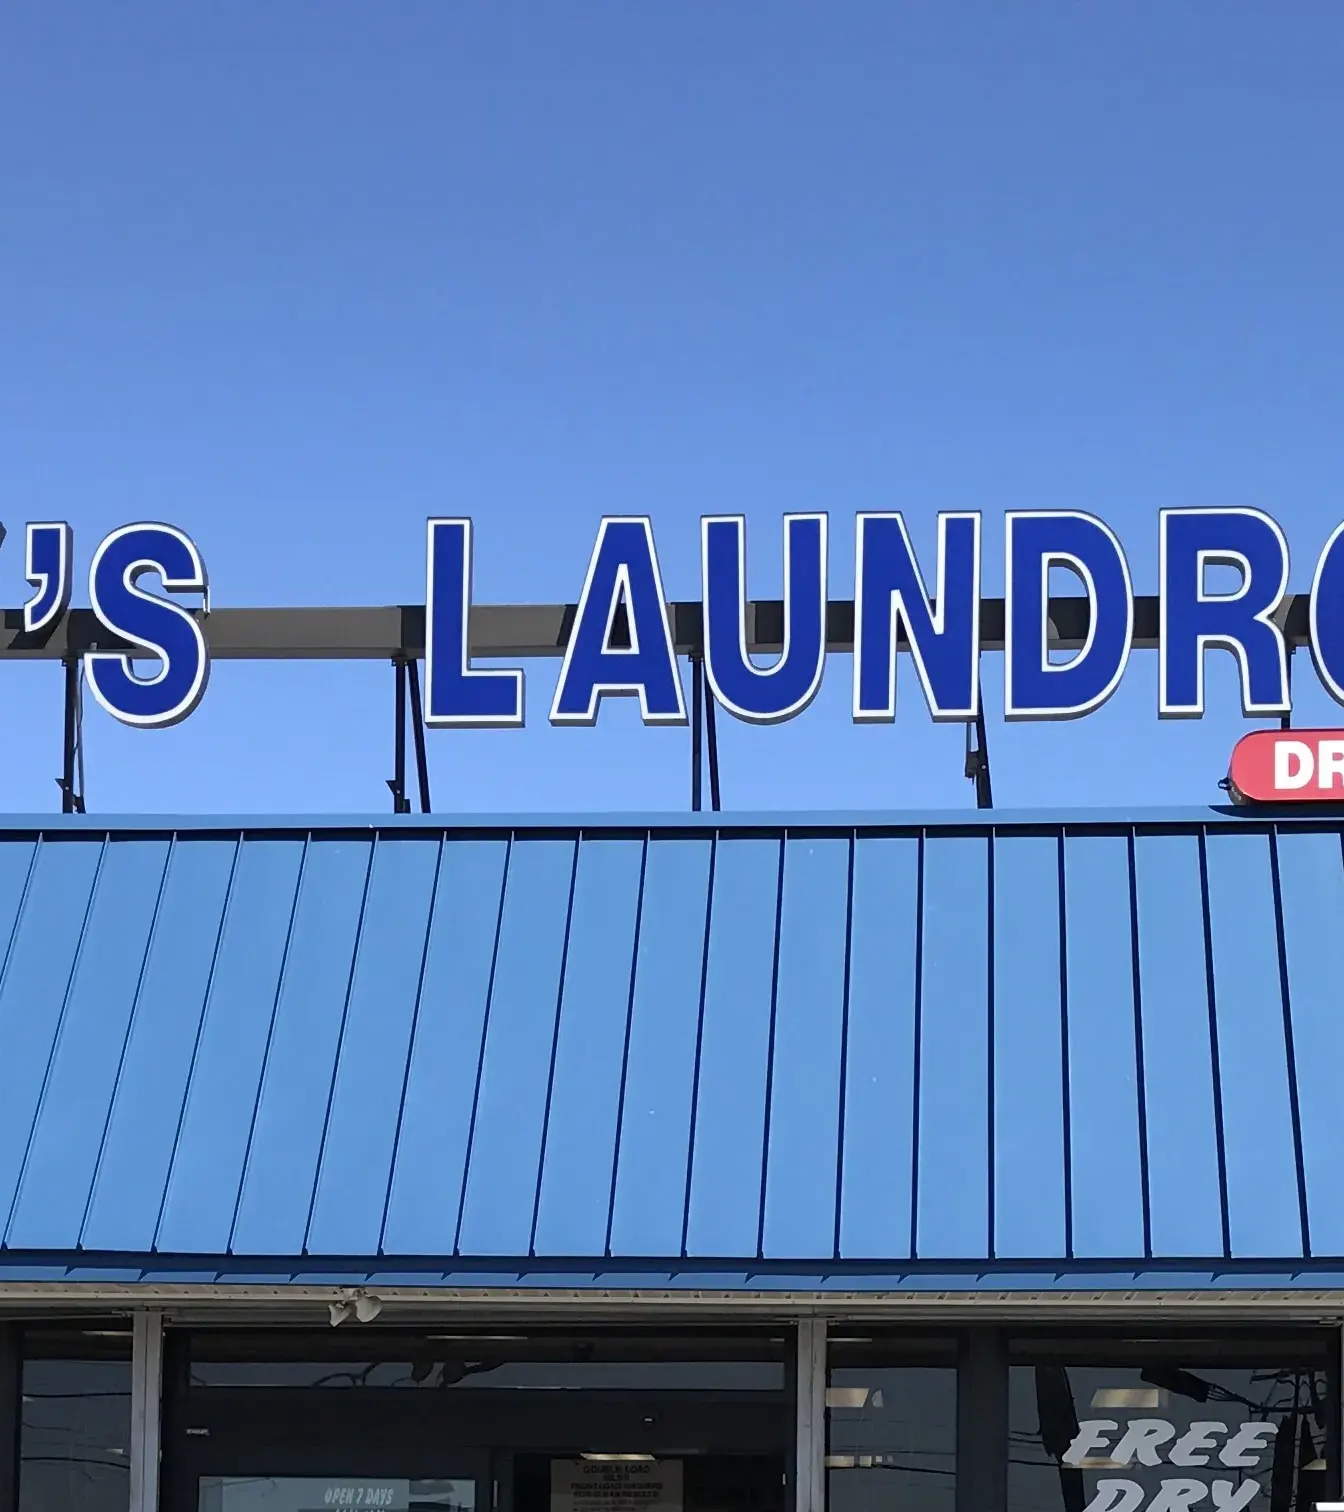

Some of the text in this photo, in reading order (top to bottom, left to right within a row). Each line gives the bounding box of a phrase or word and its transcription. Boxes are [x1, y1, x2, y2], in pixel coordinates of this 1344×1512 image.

[1062, 1419, 1278, 1467] FREE
[324, 1488, 395, 1505] OPEN 7 DAYS
